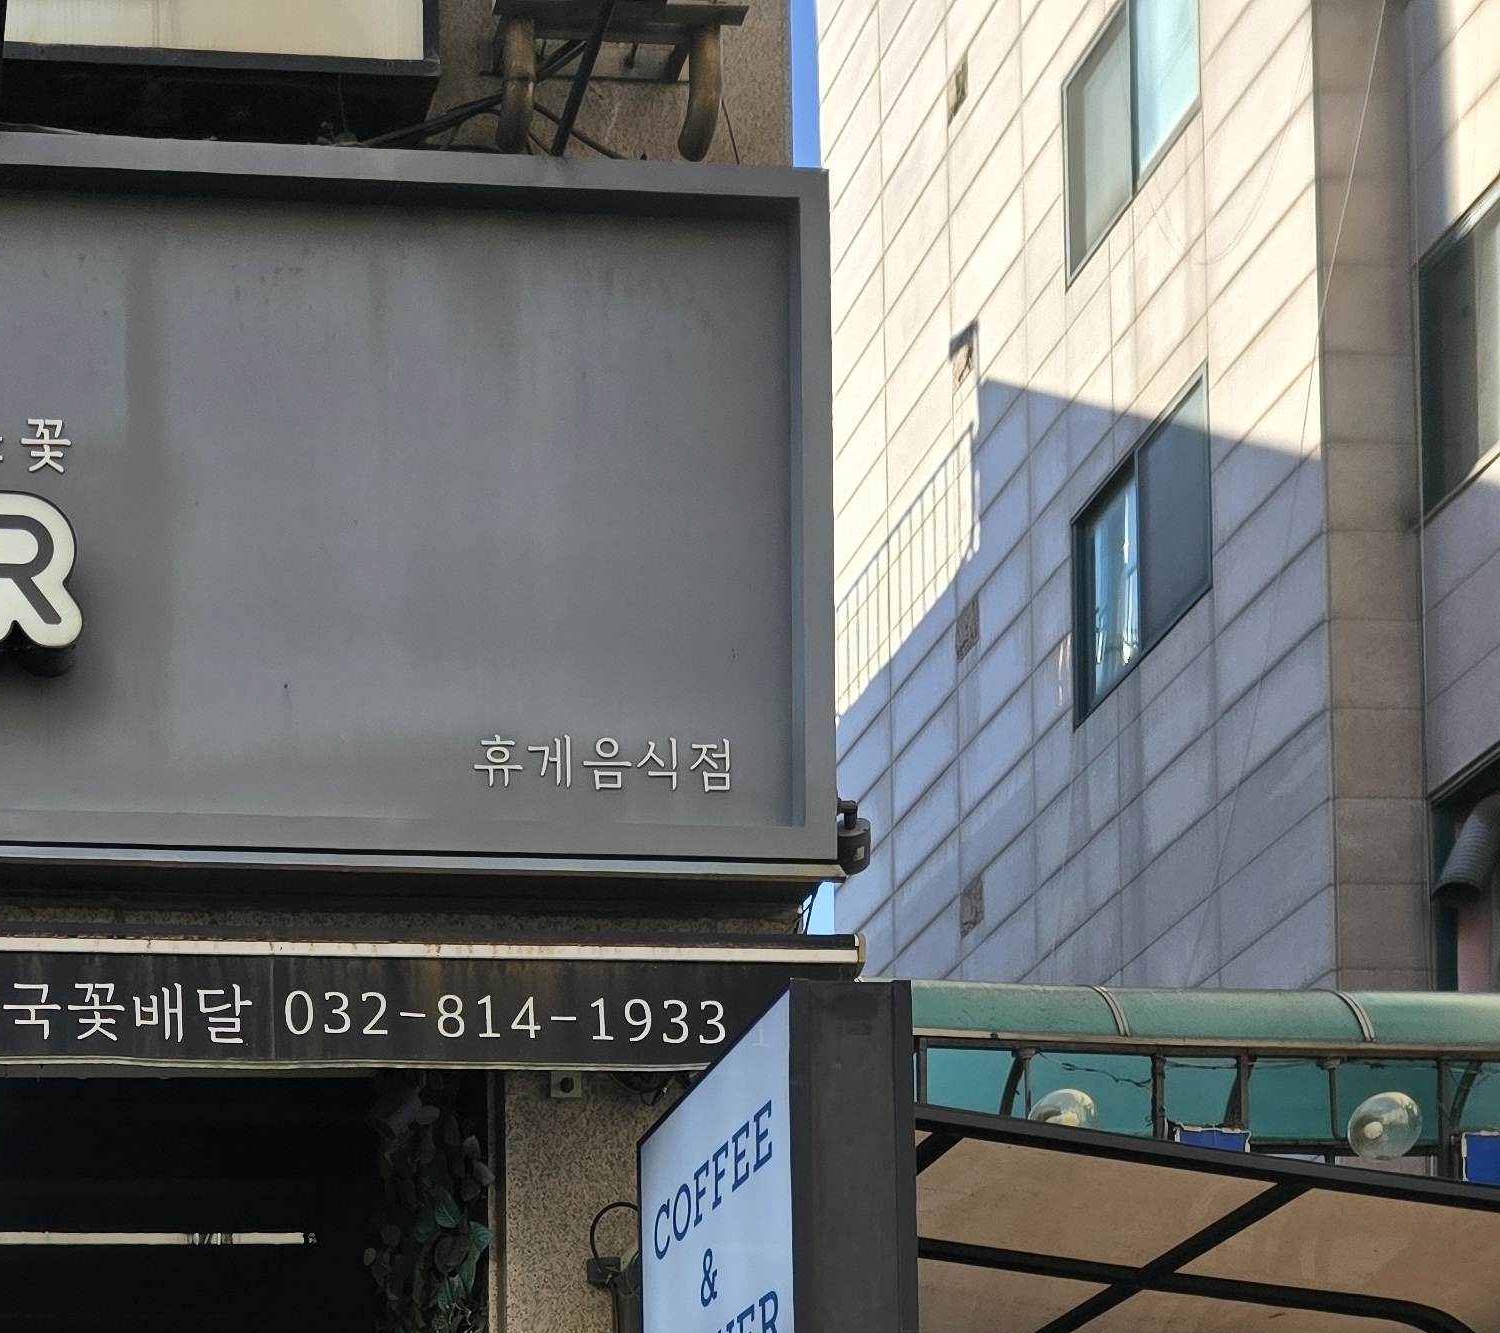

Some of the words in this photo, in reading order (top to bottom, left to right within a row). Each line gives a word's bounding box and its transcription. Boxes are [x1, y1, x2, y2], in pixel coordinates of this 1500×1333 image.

[21, 417, 73, 474] 꽃
[473, 732, 735, 795] 휴게음식점
[283, 989, 728, 1046] 032-814-1933
[653, 1098, 773, 1261] COFFEE
[700, 1247, 719, 1308] &
